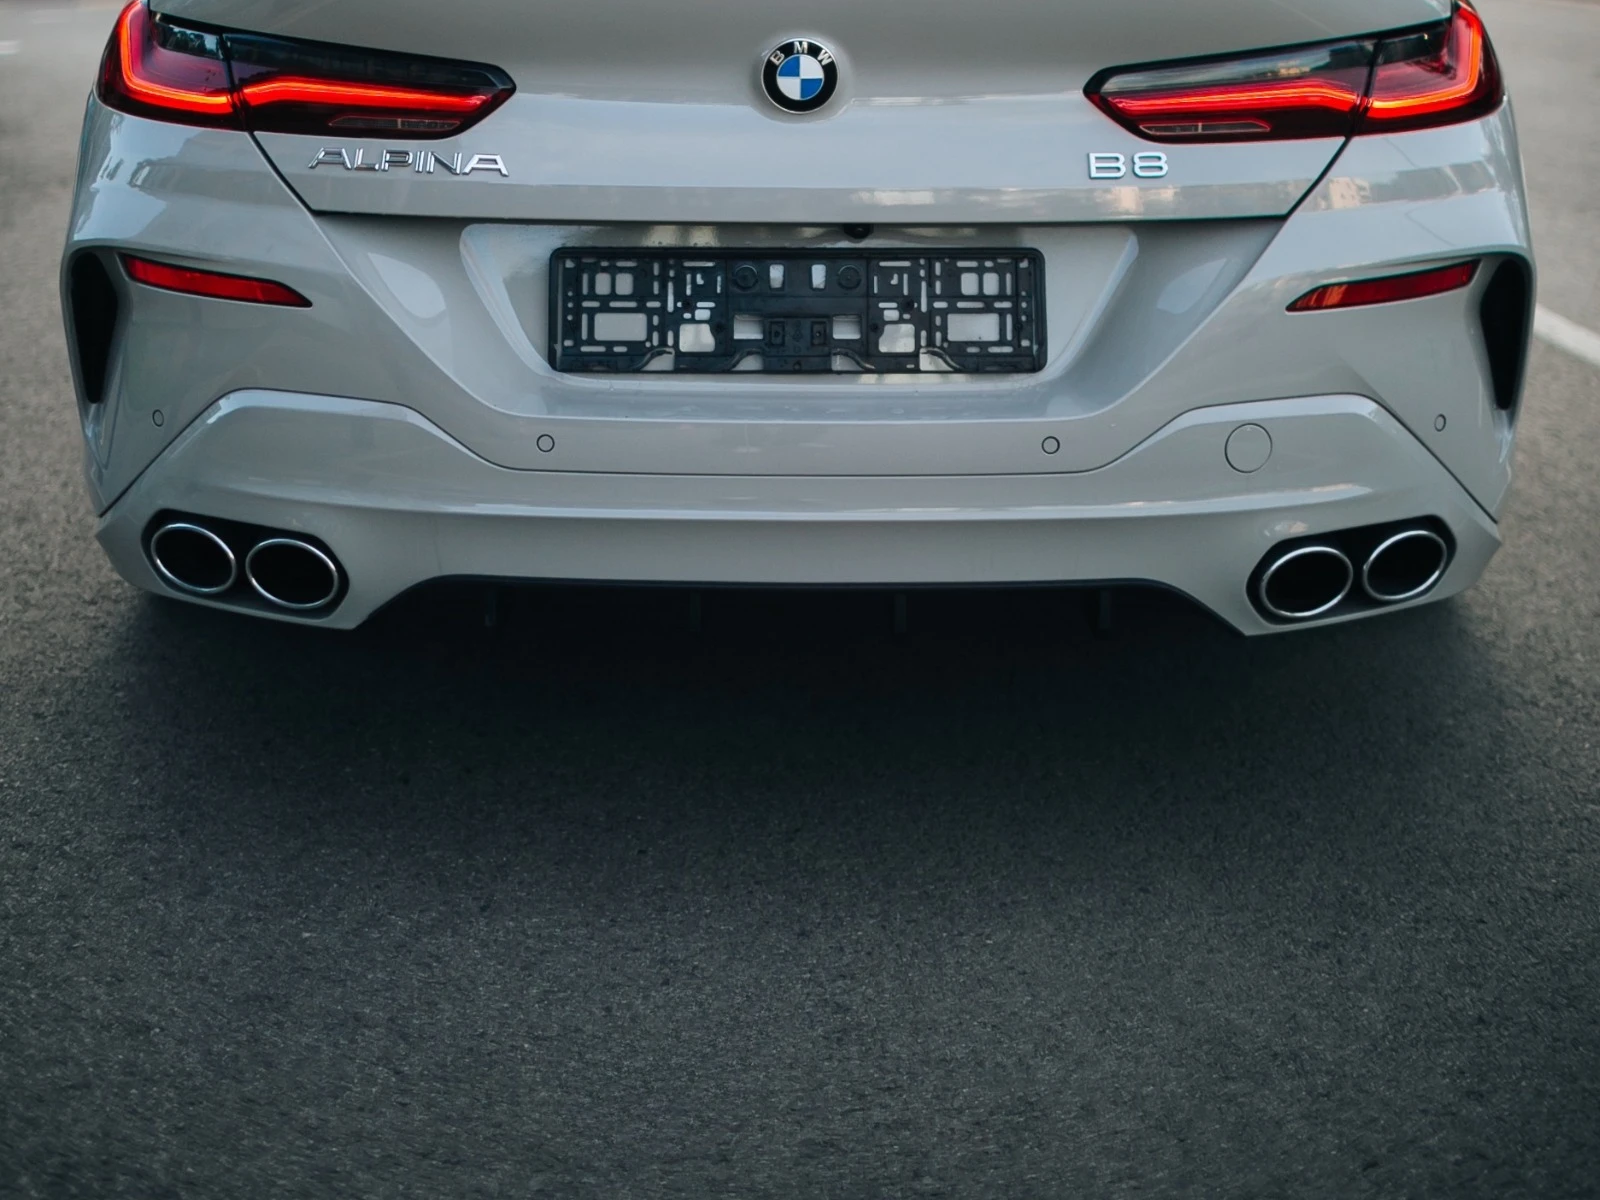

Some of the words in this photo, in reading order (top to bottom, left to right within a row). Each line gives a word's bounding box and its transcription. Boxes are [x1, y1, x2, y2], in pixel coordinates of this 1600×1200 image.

[769, 41, 833, 67] BMW
[308, 147, 509, 177] ALPINA
[1087, 151, 1169, 179] B8
